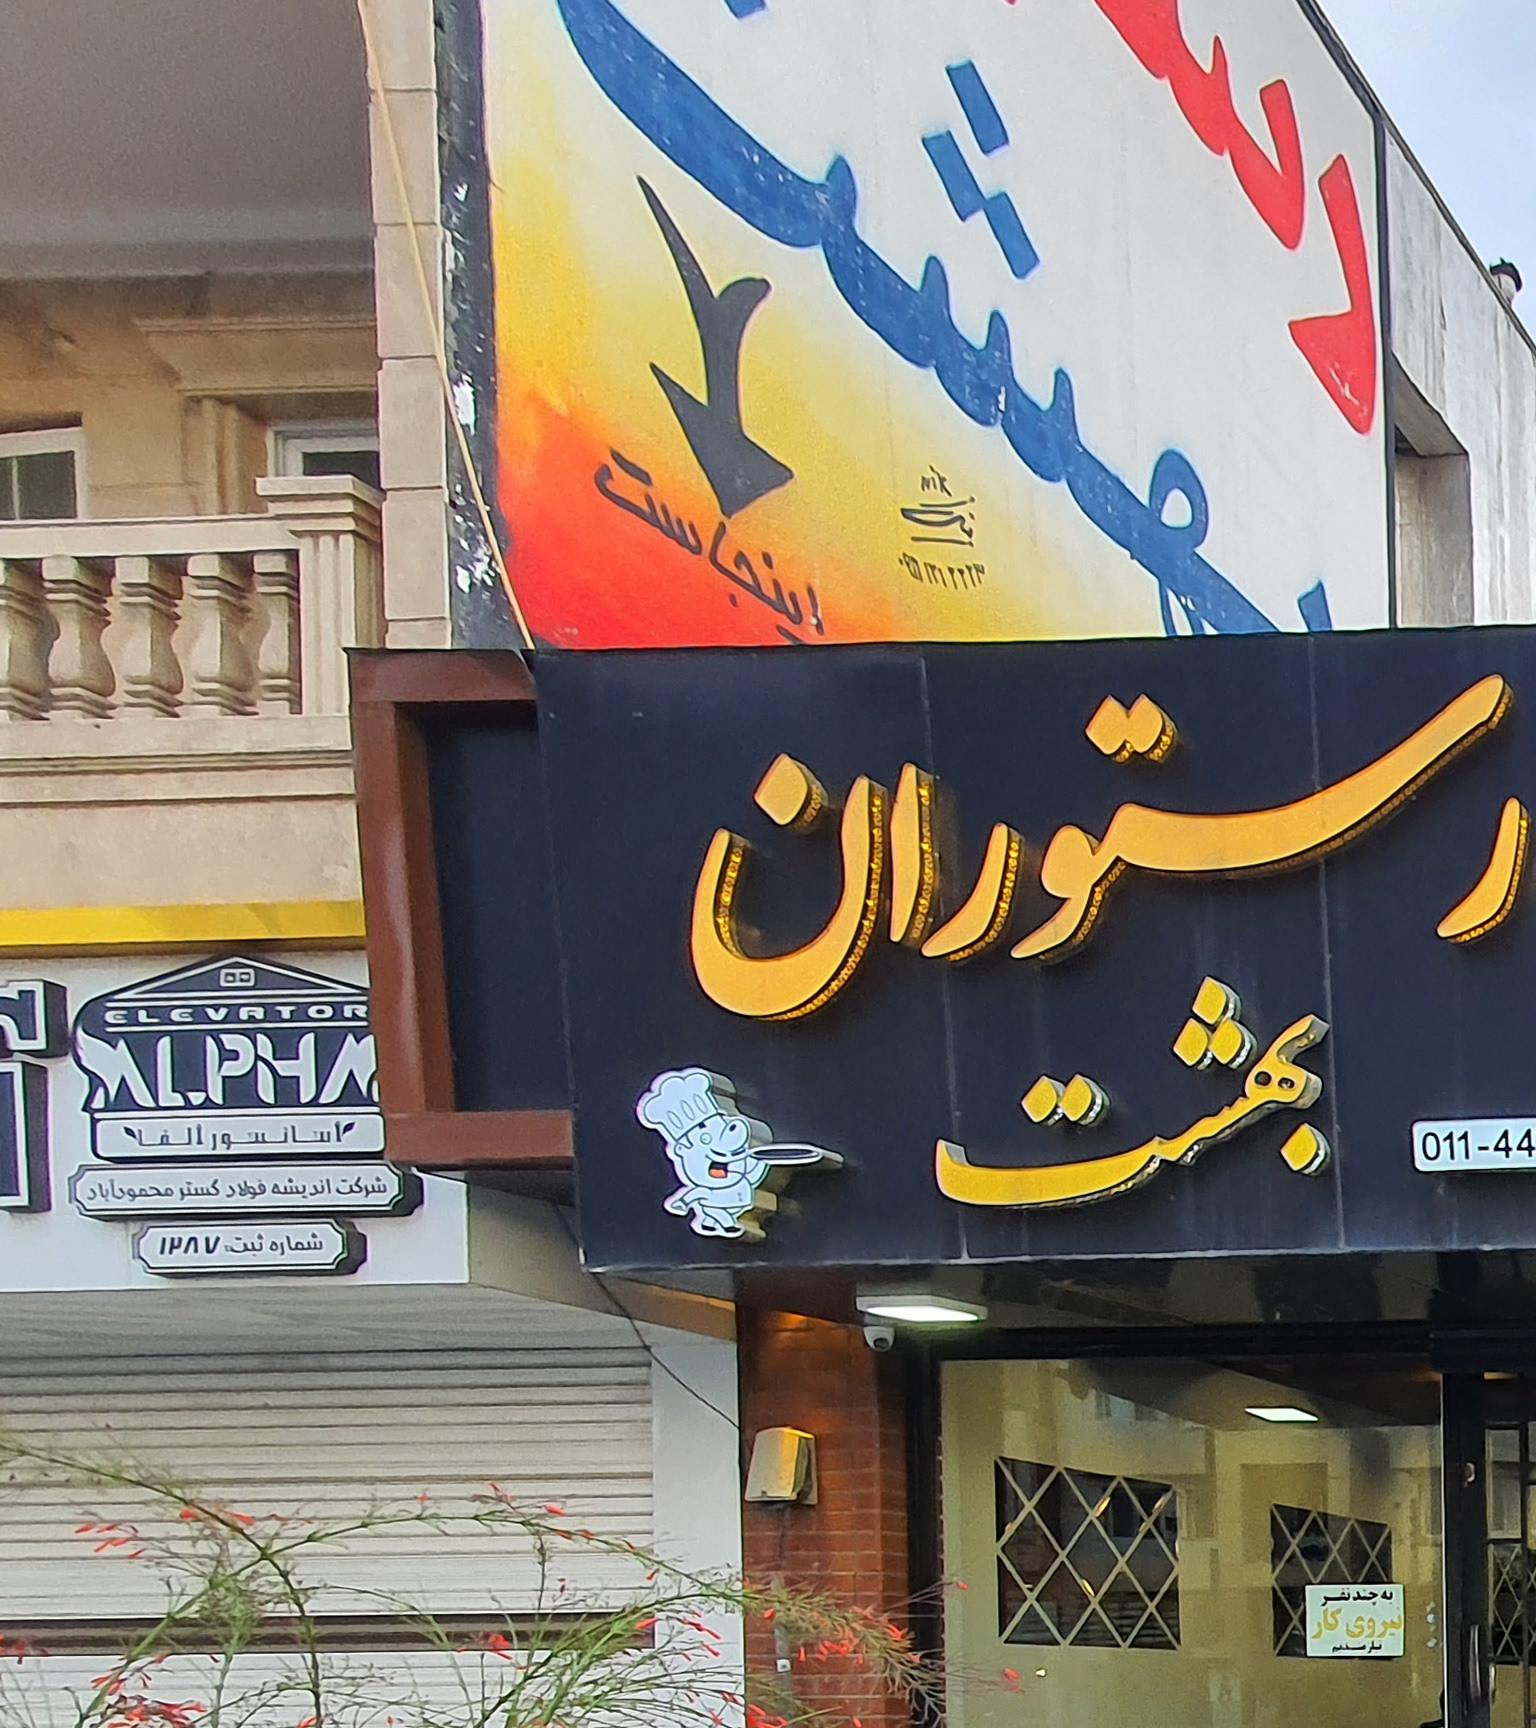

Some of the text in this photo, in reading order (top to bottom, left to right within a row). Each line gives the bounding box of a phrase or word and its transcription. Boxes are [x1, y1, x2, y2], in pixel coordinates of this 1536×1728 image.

[690, 673, 1532, 1019] رستوران
[105, 1004, 368, 1024] ELEVATOR
[935, 975, 1328, 1209] بهشت
[226, 1179, 267, 1200] فولاد
[270, 1177, 332, 1199] اندیشه
[336, 1175, 388, 1198] شرکت
[269, 1231, 324, 1256] شماره
[1320, 1587, 1393, 1606] به چند نفر
[1311, 1606, 1404, 1639] نیروی کار
